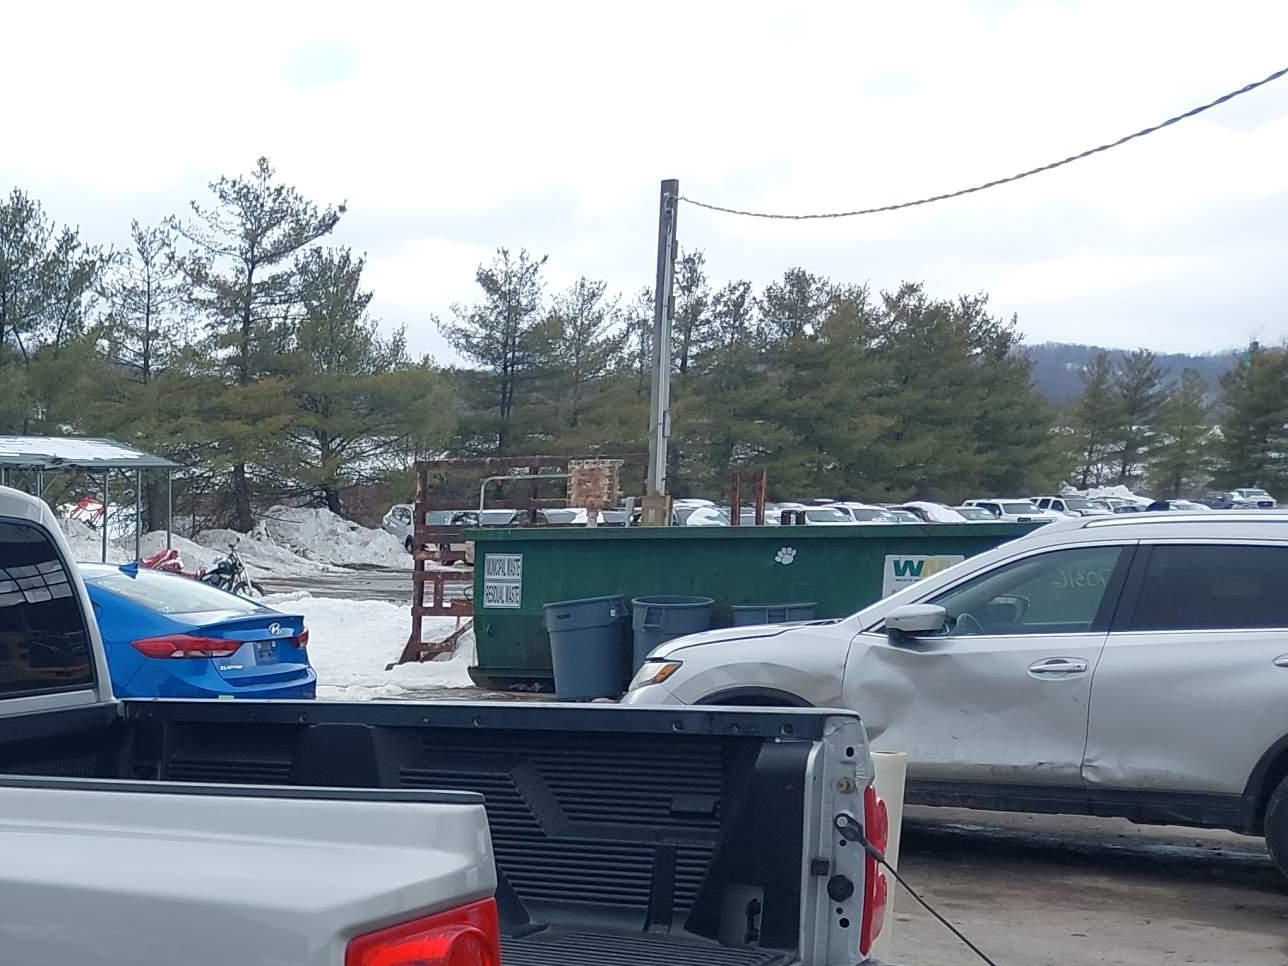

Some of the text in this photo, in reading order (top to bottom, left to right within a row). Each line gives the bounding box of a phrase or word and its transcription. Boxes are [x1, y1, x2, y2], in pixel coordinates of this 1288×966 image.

[485, 558, 521, 577] MUNICIPAL WASTE
[485, 585, 520, 604] RESIDUAL WASTE
